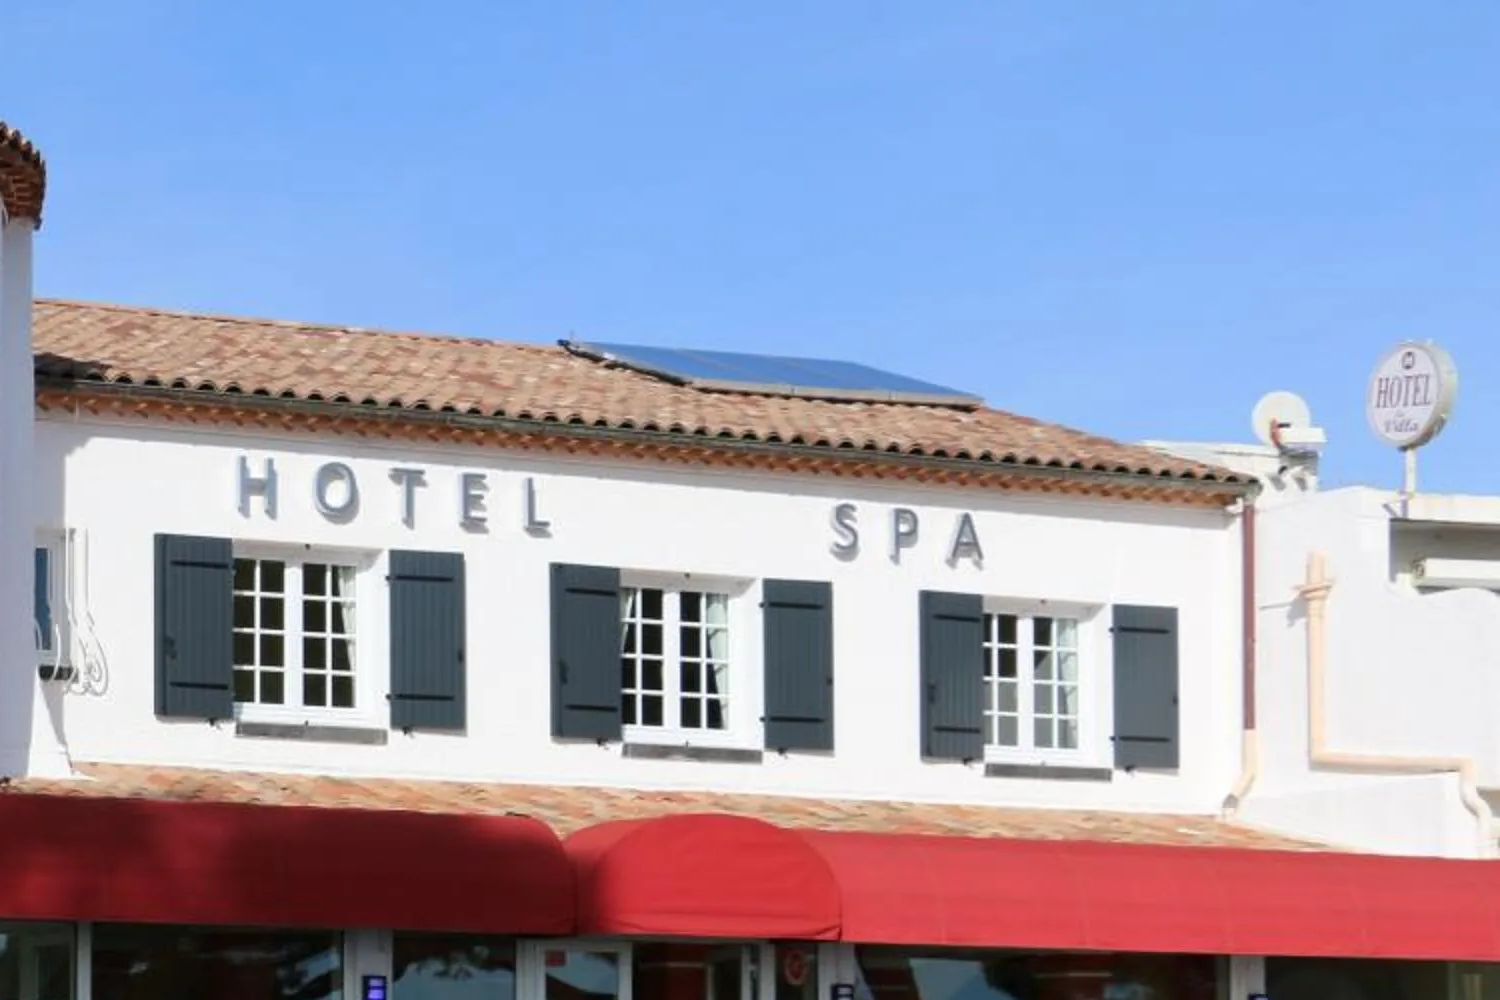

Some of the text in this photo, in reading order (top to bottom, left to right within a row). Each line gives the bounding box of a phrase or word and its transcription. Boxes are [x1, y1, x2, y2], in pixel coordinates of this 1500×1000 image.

[1375, 373, 1431, 408] HOTEL
[237, 456, 985, 568] HOTEL SPA
